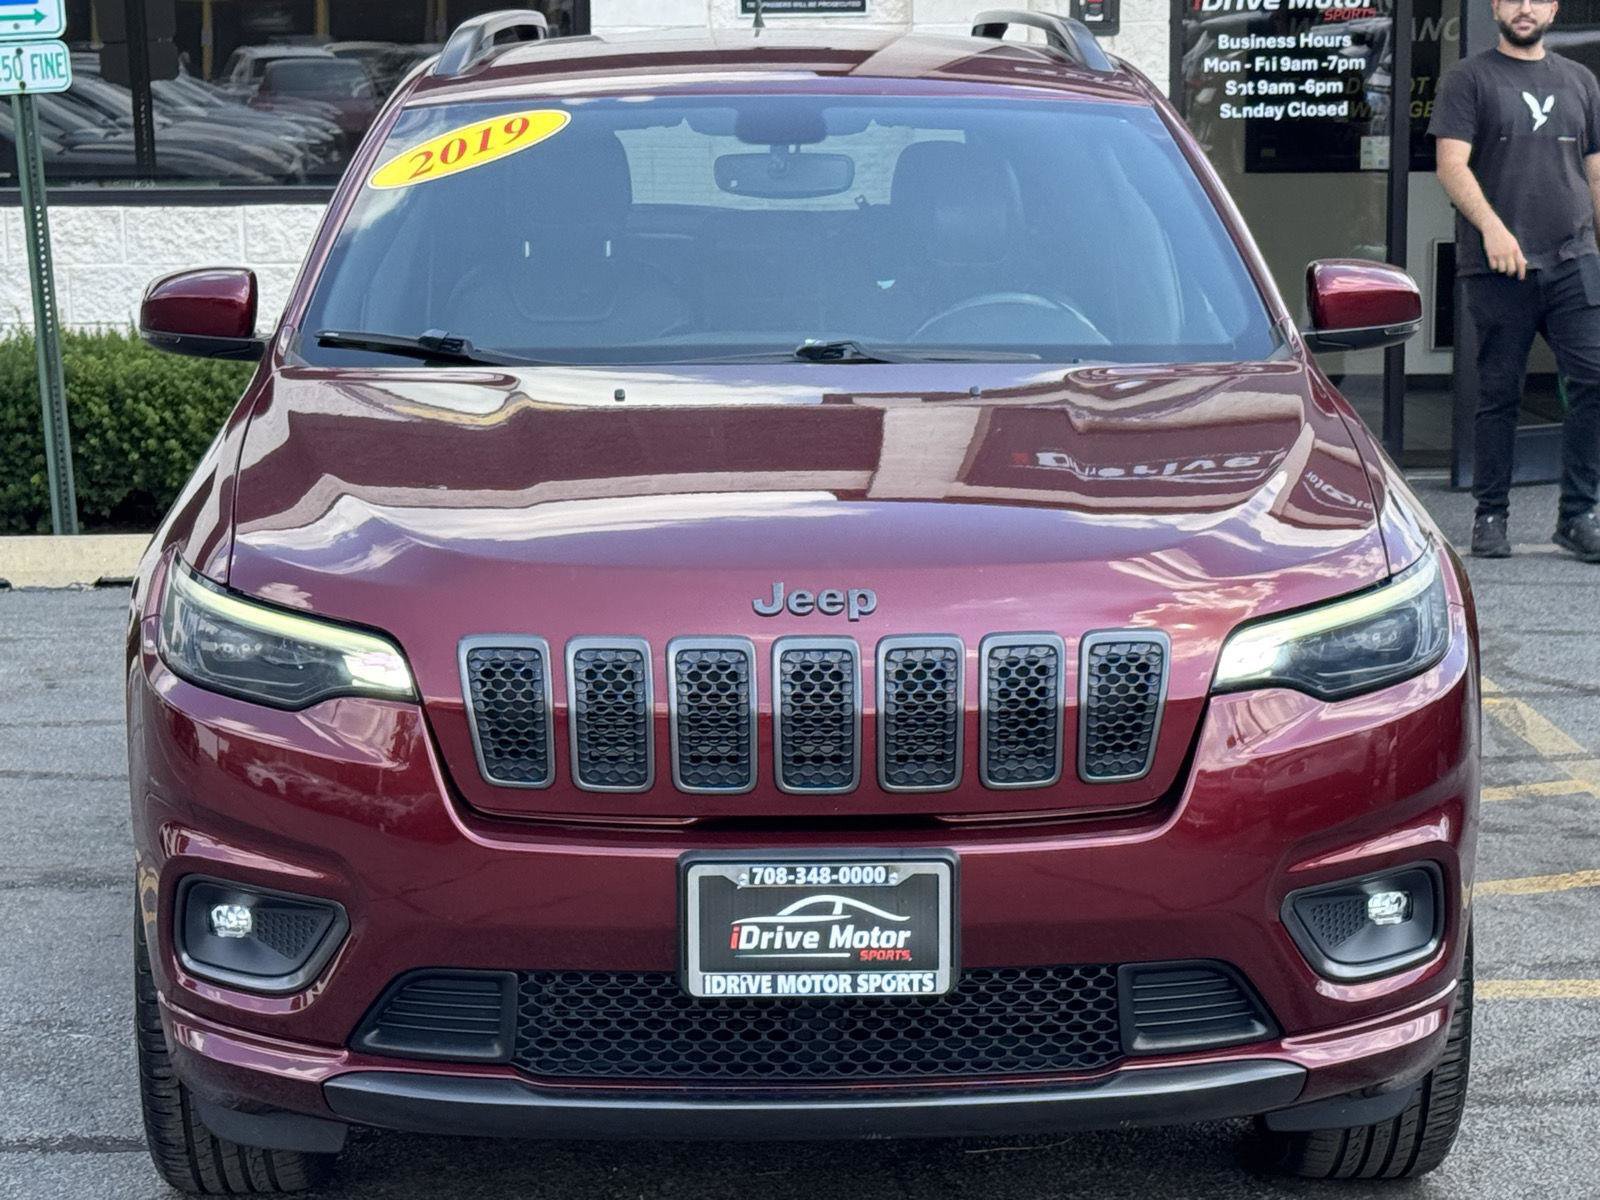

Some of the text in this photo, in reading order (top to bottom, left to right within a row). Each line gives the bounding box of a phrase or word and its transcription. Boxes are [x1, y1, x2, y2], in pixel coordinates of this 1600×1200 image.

[1218, 32, 1352, 50] Business Hours
[0, 53, 66, 81] 50 FINE
[1203, 57, 1241, 73] Mon
[1280, 56, 1318, 72] 9am
[1257, 79, 1295, 95] 9am
[1287, 100, 1348, 117] Closed
[408, 117, 530, 180] 2019
[752, 581, 877, 622] Jeep
[752, 866, 886, 885] 708-348-0000
[730, 924, 911, 950] iDrive Motor
[860, 949, 911, 961] SPORTS
[777, 973, 852, 994] MOTOR
[857, 973, 935, 993] SPORTS
